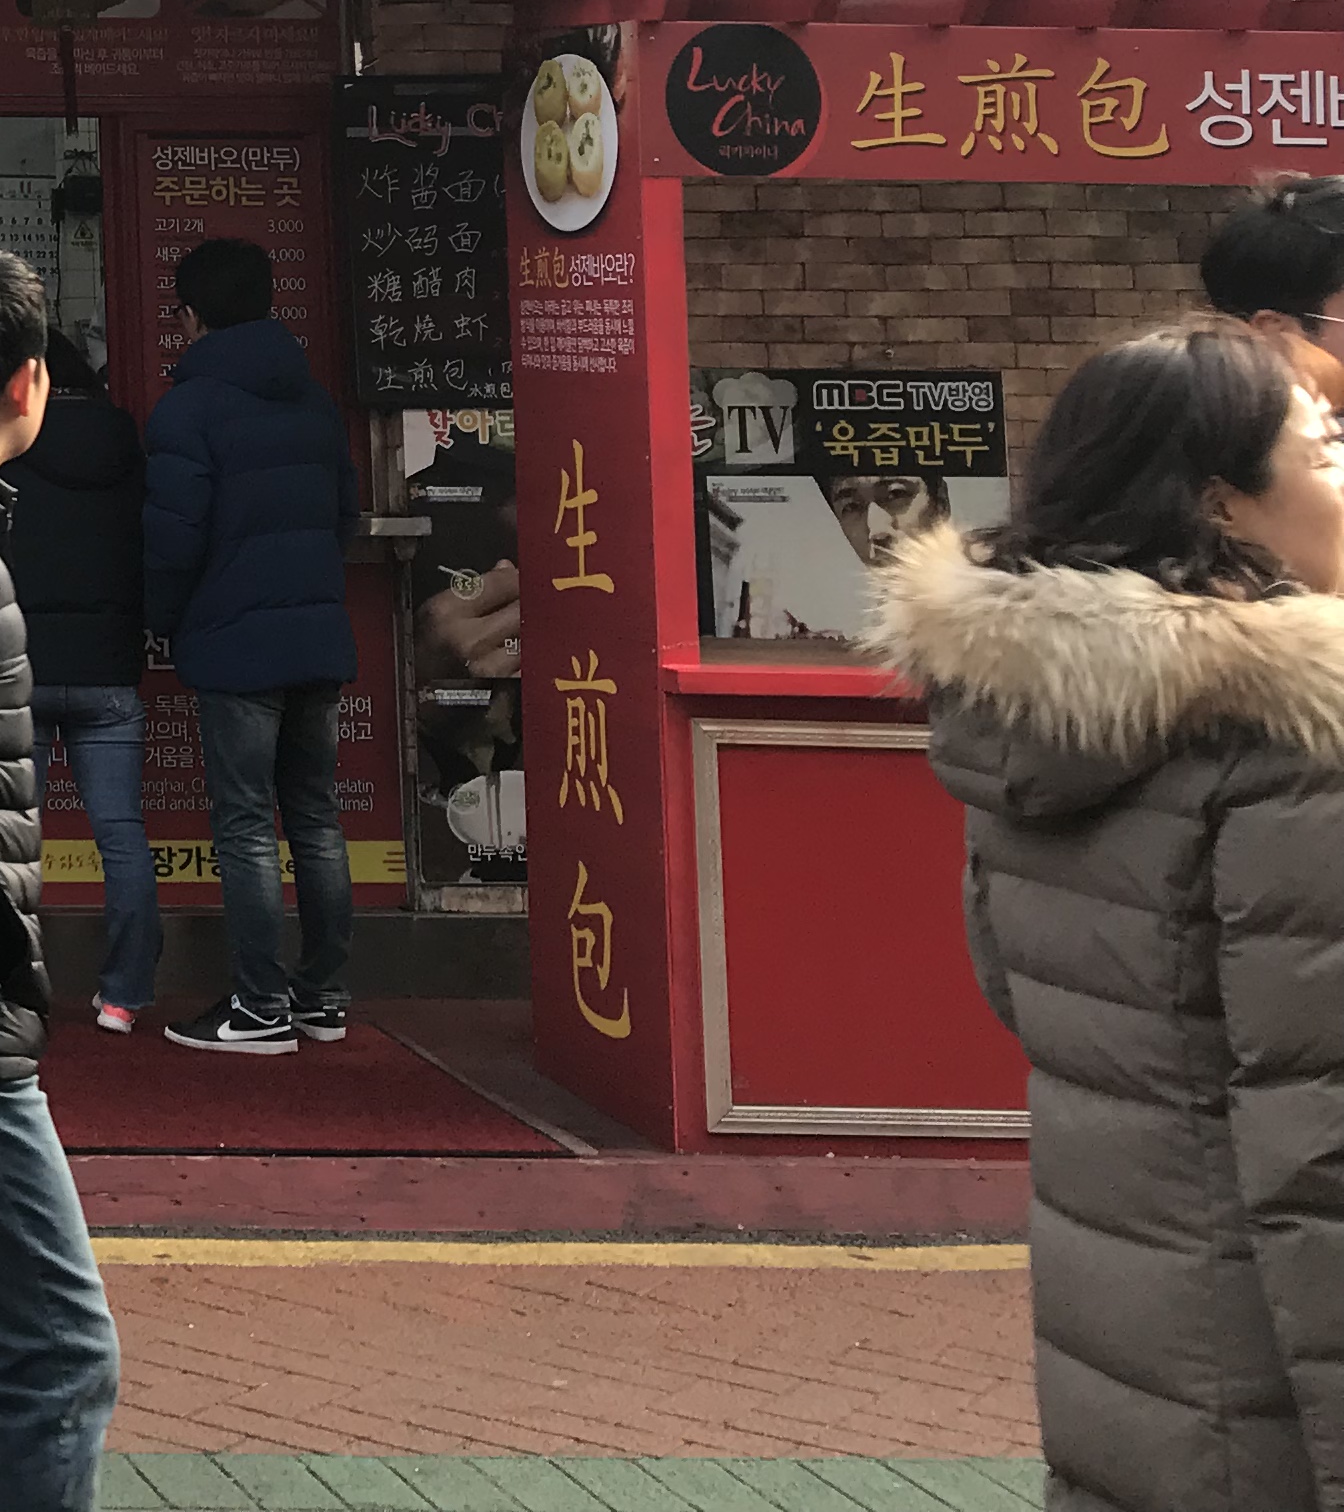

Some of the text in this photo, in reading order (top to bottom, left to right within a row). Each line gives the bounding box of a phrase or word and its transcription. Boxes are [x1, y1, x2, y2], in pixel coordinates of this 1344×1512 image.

[686, 46, 786, 108] Lucky
[711, 93, 807, 138] China
[850, 50, 1170, 160] 生煎包
[1184, 66, 1344, 150] 성젠
[367, 101, 452, 158] Lucky
[151, 145, 301, 172] 성젠바오(만두)
[152, 176, 303, 208] 주문하는 곳
[11, 216, 17, 225] 6
[23, 217, 30, 225] 7
[37, 217, 43, 225] 8
[154, 217, 304, 234] 고기 2개 3,000
[9, 233, 20, 242] 13
[22, 233, 32, 242] 14
[35, 233, 46, 242] 15
[361, 222, 482, 259] 炒码面
[155, 246, 182, 262] 새우
[267, 248, 306, 263] 4,000
[519, 246, 636, 289] 生煎包 성젠바오란?
[366, 265, 477, 303] 糖醋肉
[269, 306, 308, 321] 5,000
[157, 333, 185, 350] 새우
[375, 357, 470, 392] 生煎包
[812, 378, 996, 412] MBC TV방영
[727, 404, 792, 455] TV
[504, 637, 520, 656] 먼
[338, 694, 373, 718] 하여
[337, 720, 374, 744] 하고
[551, 438, 633, 1040] 生煎包
[145, 745, 194, 769] 거움을
[141, 778, 190, 796] anghai,
[141, 796, 165, 811] ried
[169, 796, 194, 811] and
[339, 795, 374, 813] time)
[153, 846, 221, 878] 장가
[467, 843, 497, 863] 만두
